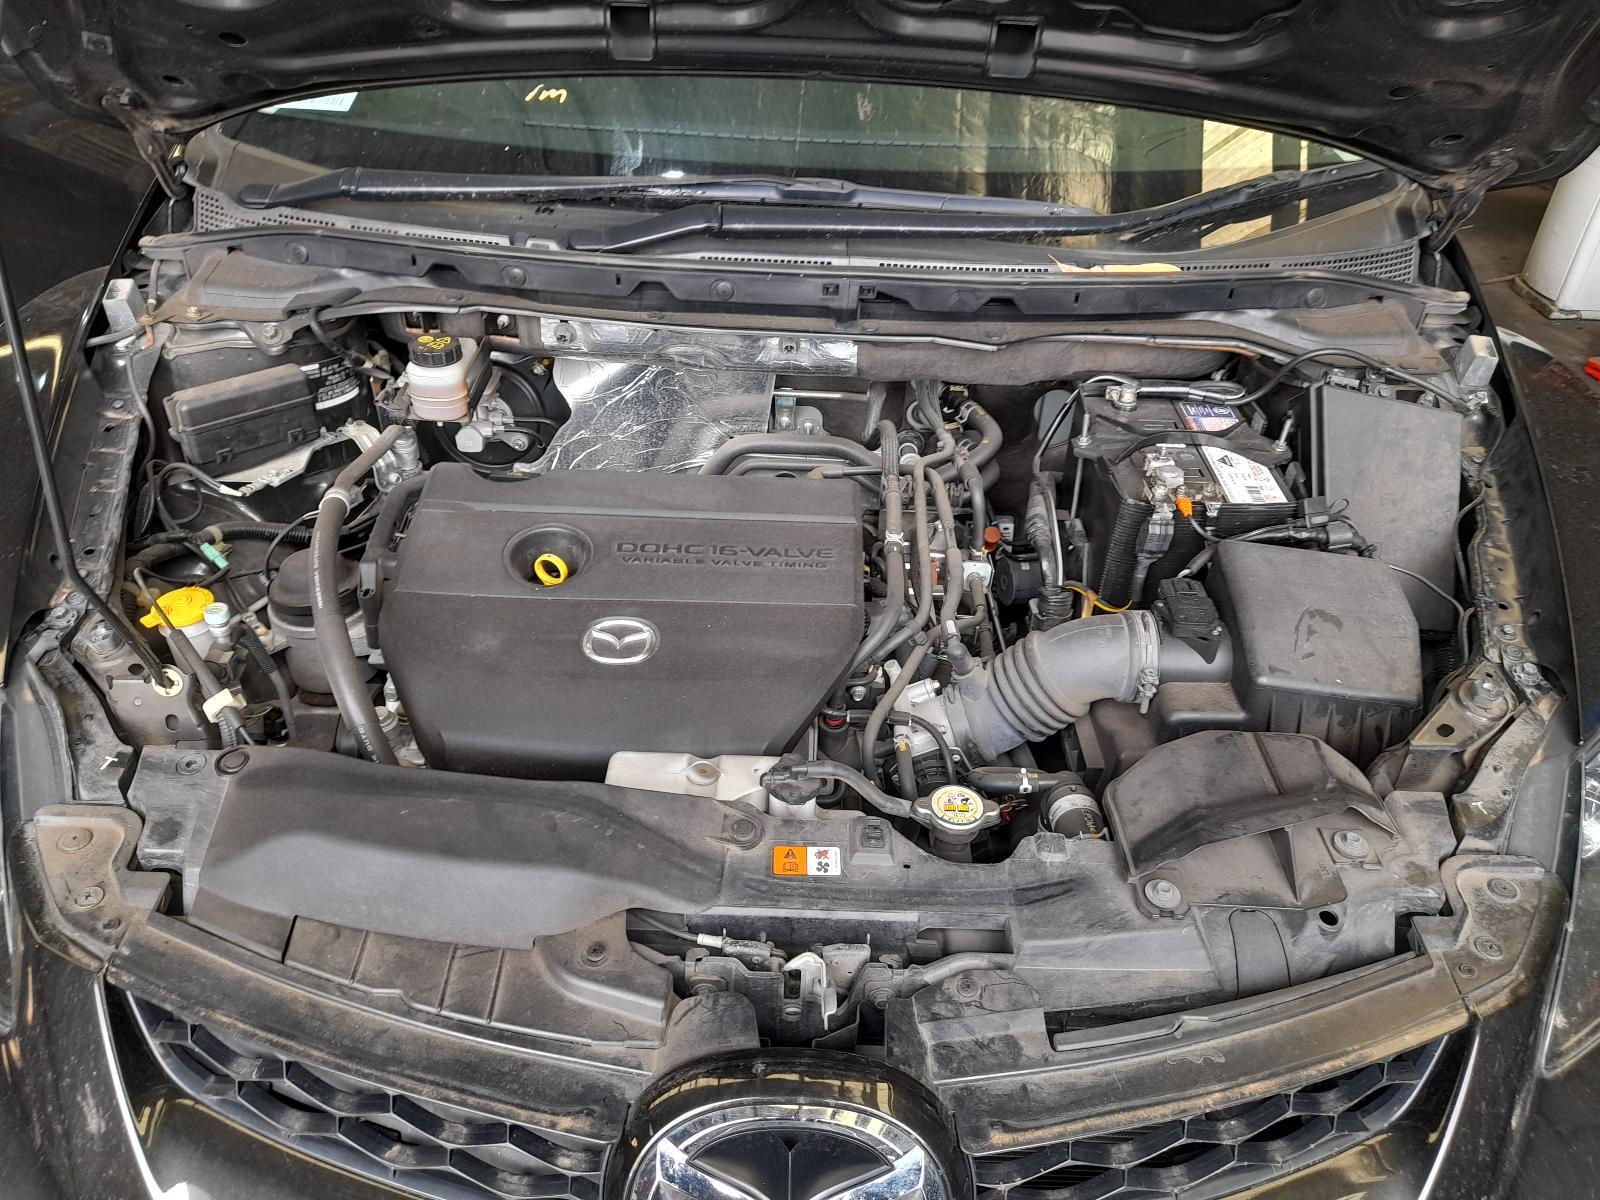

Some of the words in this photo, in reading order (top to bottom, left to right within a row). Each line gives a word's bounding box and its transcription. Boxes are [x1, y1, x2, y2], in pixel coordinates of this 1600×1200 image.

[616, 542, 705, 555] DOHC
[710, 544, 835, 559] 16-VALVE
[621, 556, 705, 566] VARIABLE
[711, 558, 763, 568] VALVE
[769, 560, 829, 570] TIMING
